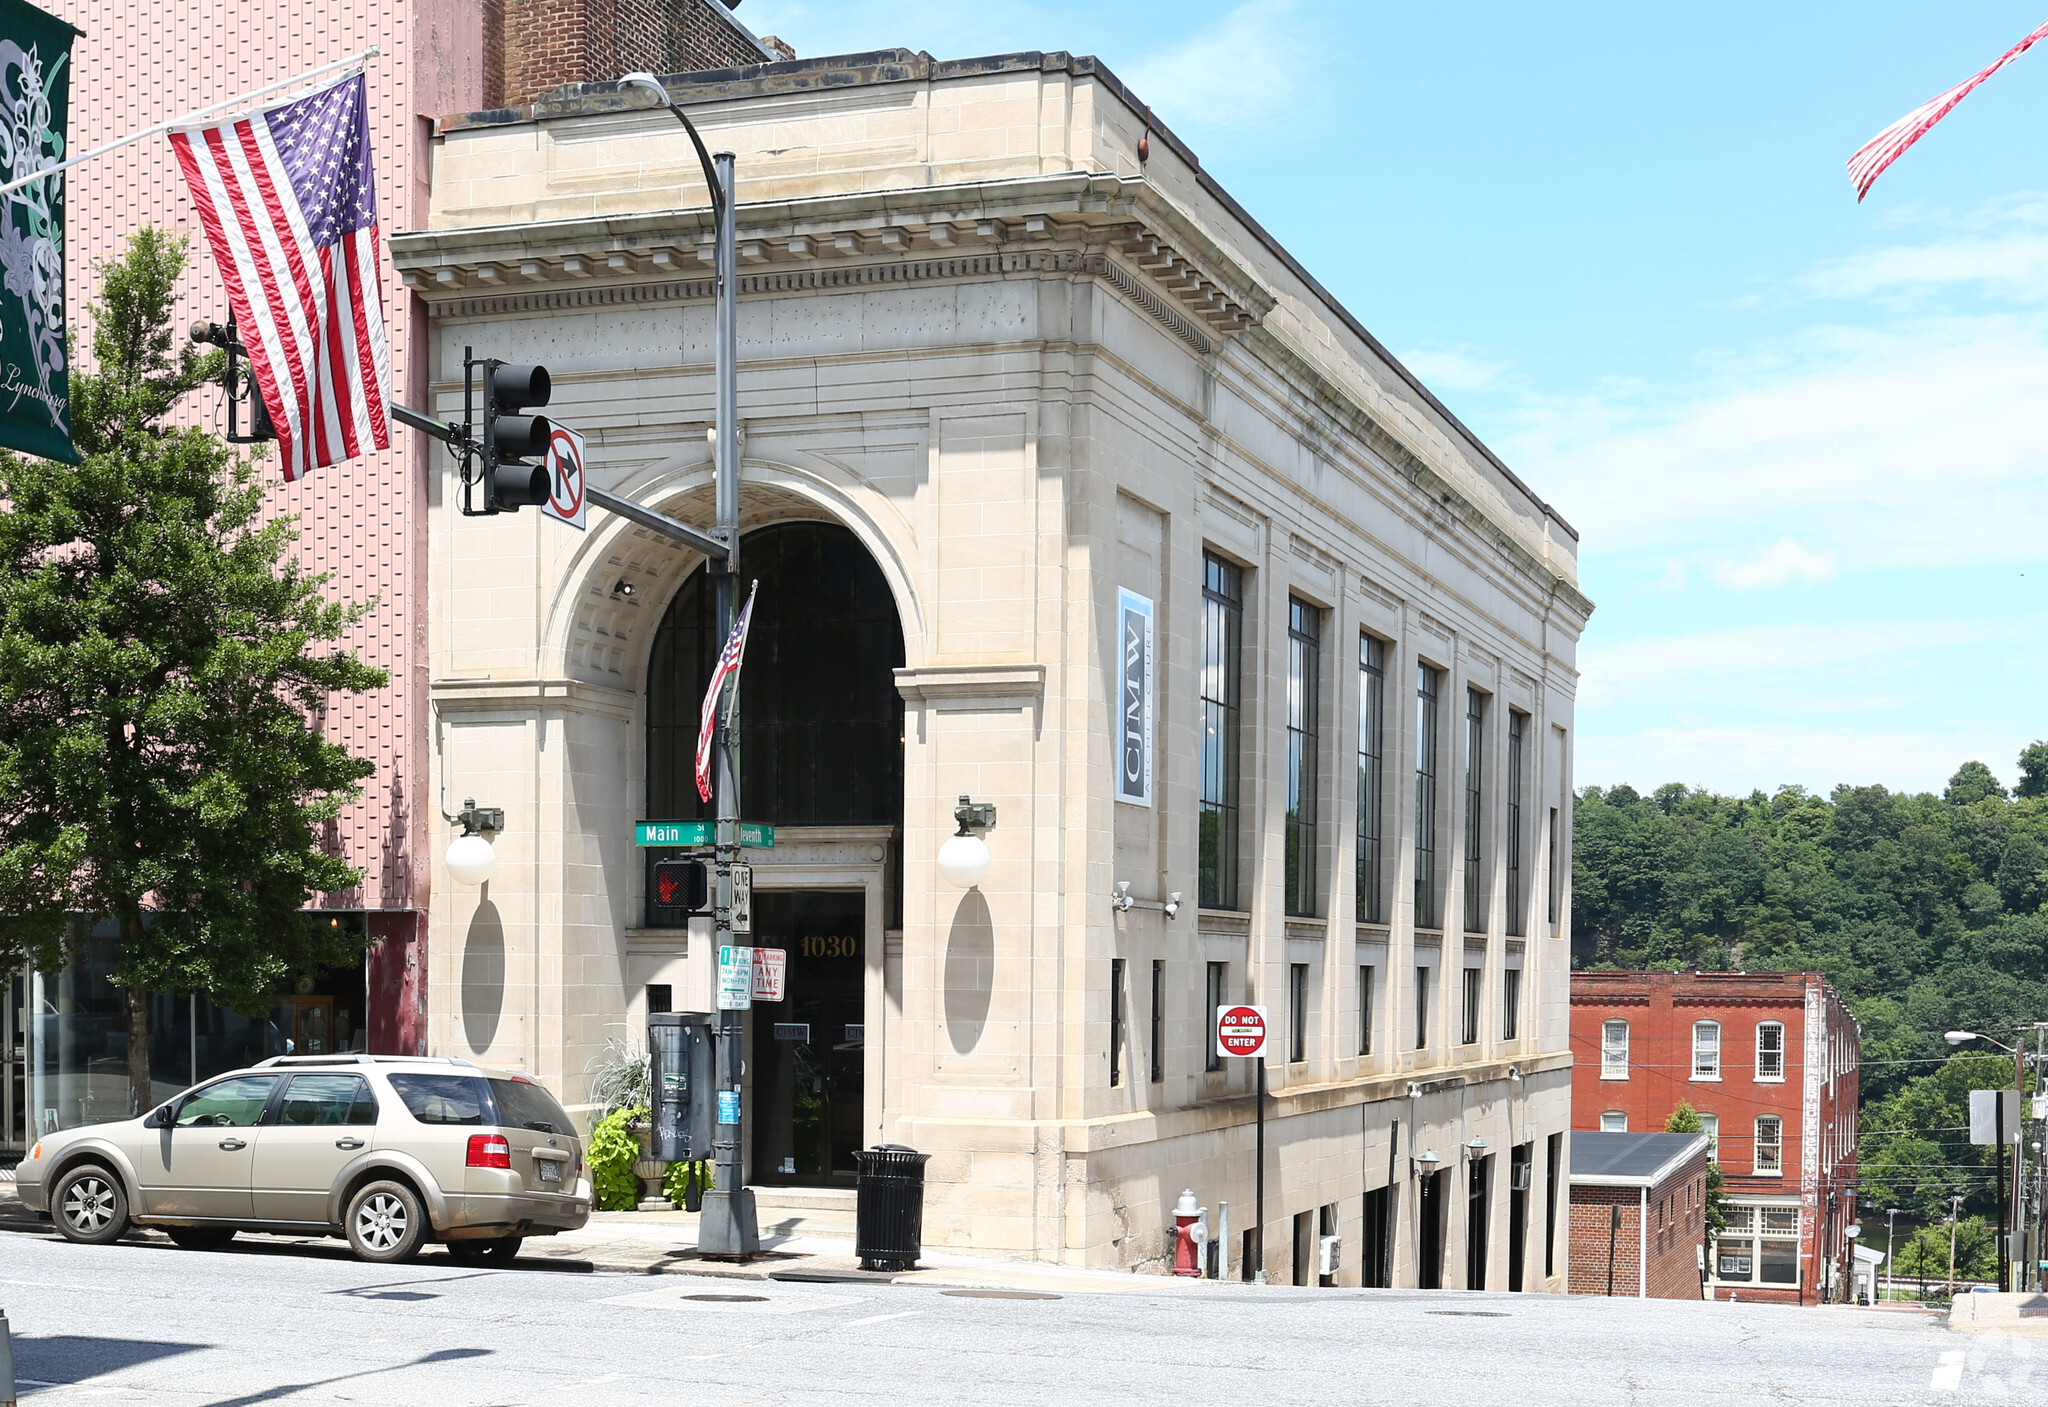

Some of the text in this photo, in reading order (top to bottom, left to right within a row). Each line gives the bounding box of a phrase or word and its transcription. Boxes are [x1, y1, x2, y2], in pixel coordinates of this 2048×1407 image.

[1125, 620, 1144, 784] CJMW
[1144, 626, 1152, 794] ARCHITECTURE
[646, 823, 705, 842] Main St
[740, 827, 762, 843] leventh
[693, 835, 709, 843] 1000
[734, 871, 749, 887] ONE
[734, 890, 749, 905] WAY
[800, 936, 856, 957] 1030
[730, 957, 750, 965] PARKING
[754, 952, 784, 962] NO PARKING
[758, 967, 778, 976] ANY
[756, 978, 779, 988] TIME
[1224, 1015, 1260, 1024] DO NOT
[776, 1027, 806, 1037] CJMW
[1228, 1038, 1256, 1047] ENTER
